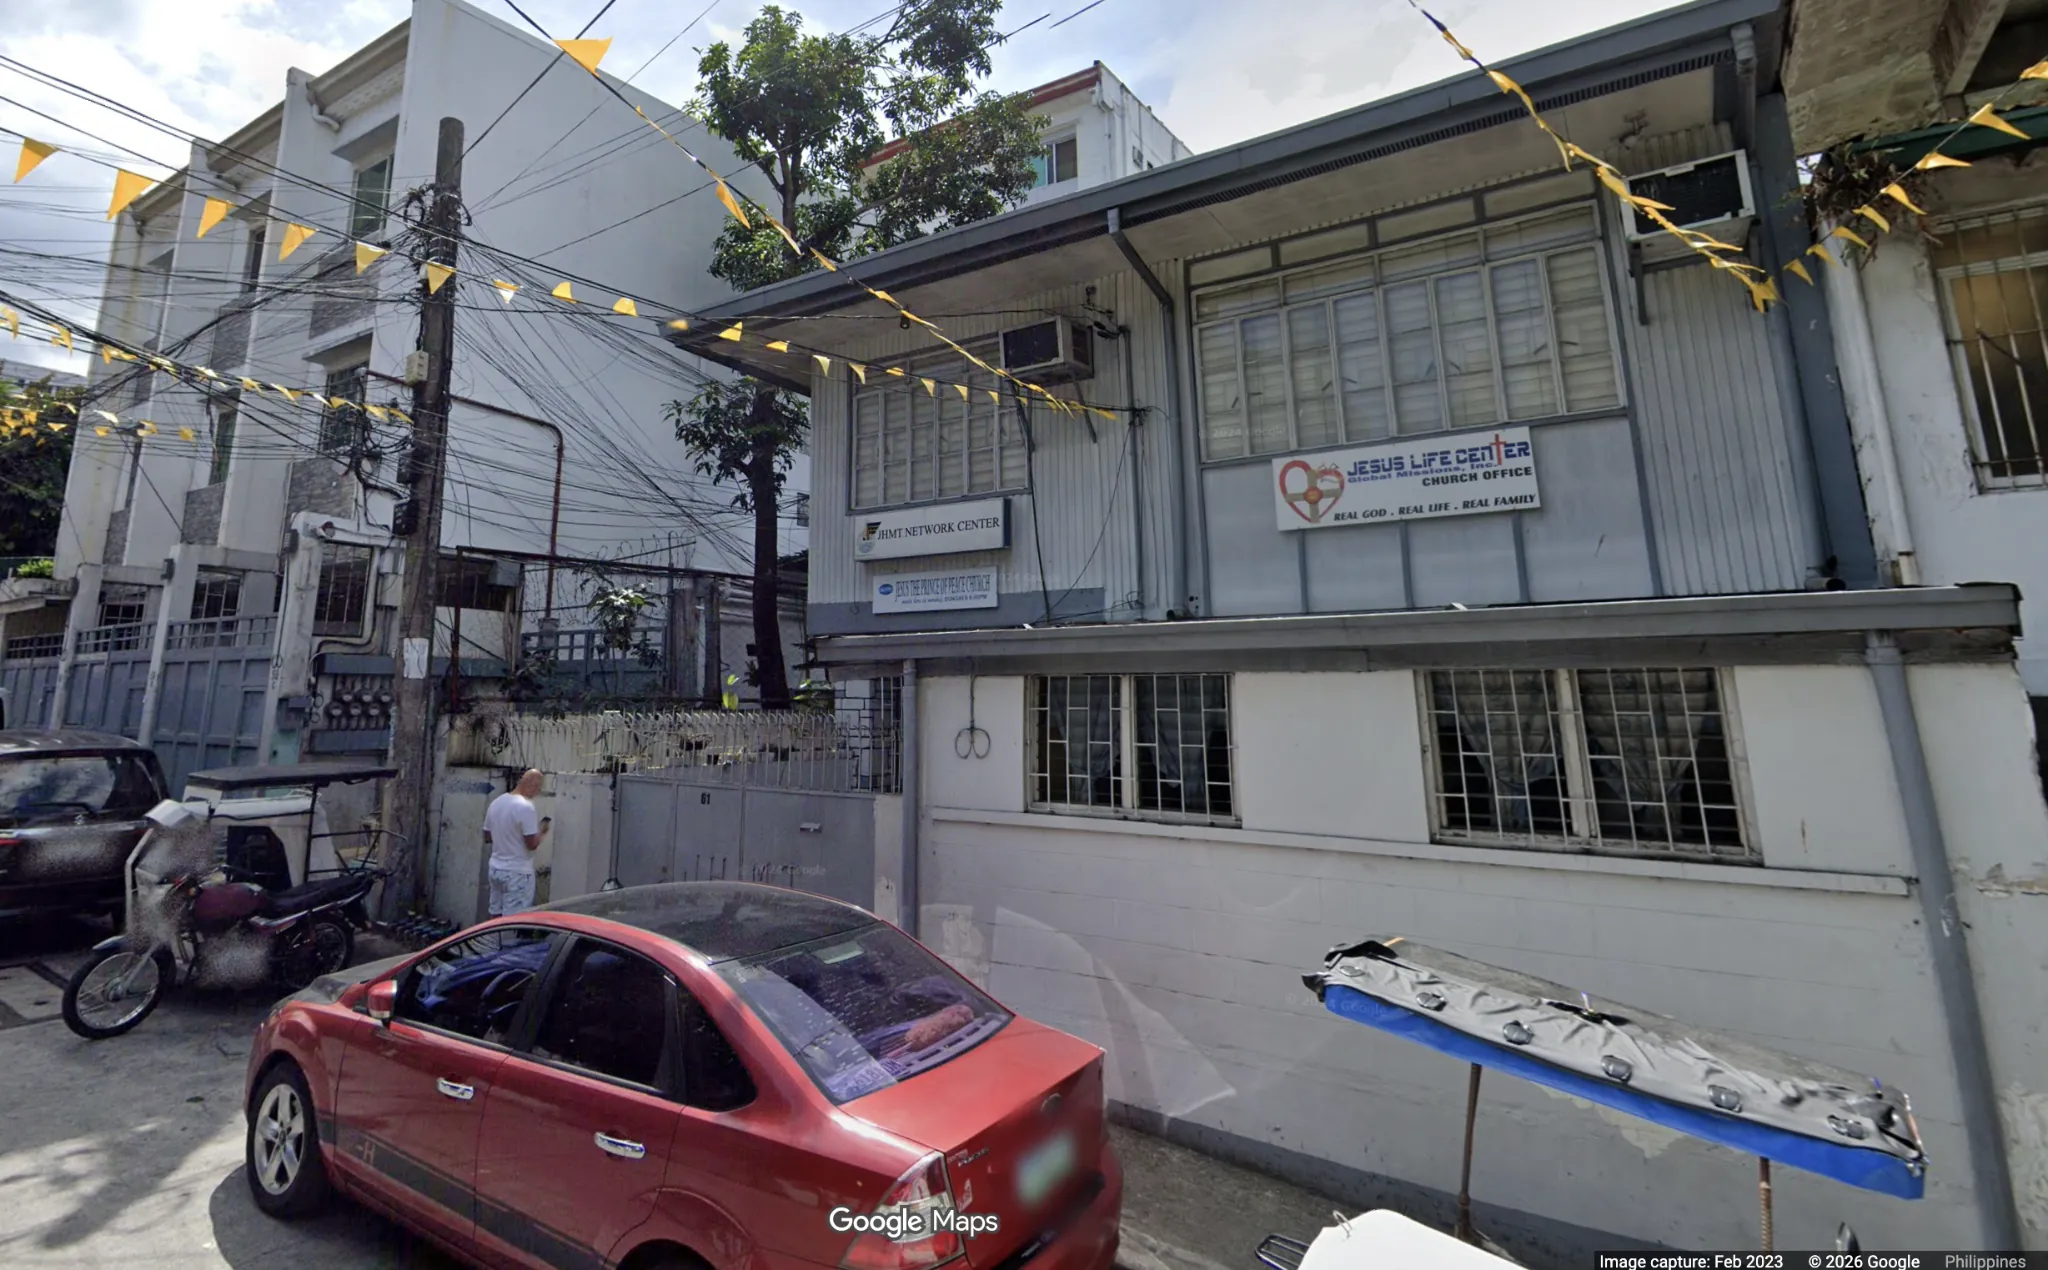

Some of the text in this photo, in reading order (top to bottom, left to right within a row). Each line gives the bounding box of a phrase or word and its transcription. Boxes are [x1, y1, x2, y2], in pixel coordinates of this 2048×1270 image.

[1347, 455, 1405, 477] JESUS
[1422, 466, 1533, 487] CHURCH OFFICE
[1347, 472, 1392, 484] Global
[1333, 493, 1537, 521] REAL GOD REAL LIFE REAL FAMILY
[877, 516, 1000, 541] JHMT NETWORK CENTER
[910, 579, 921, 596] THE
[921, 577, 940, 596] PRINCE
[940, 577, 948, 595] OF
[948, 575, 966, 594] PEACE
[966, 573, 991, 593] CHURCH
